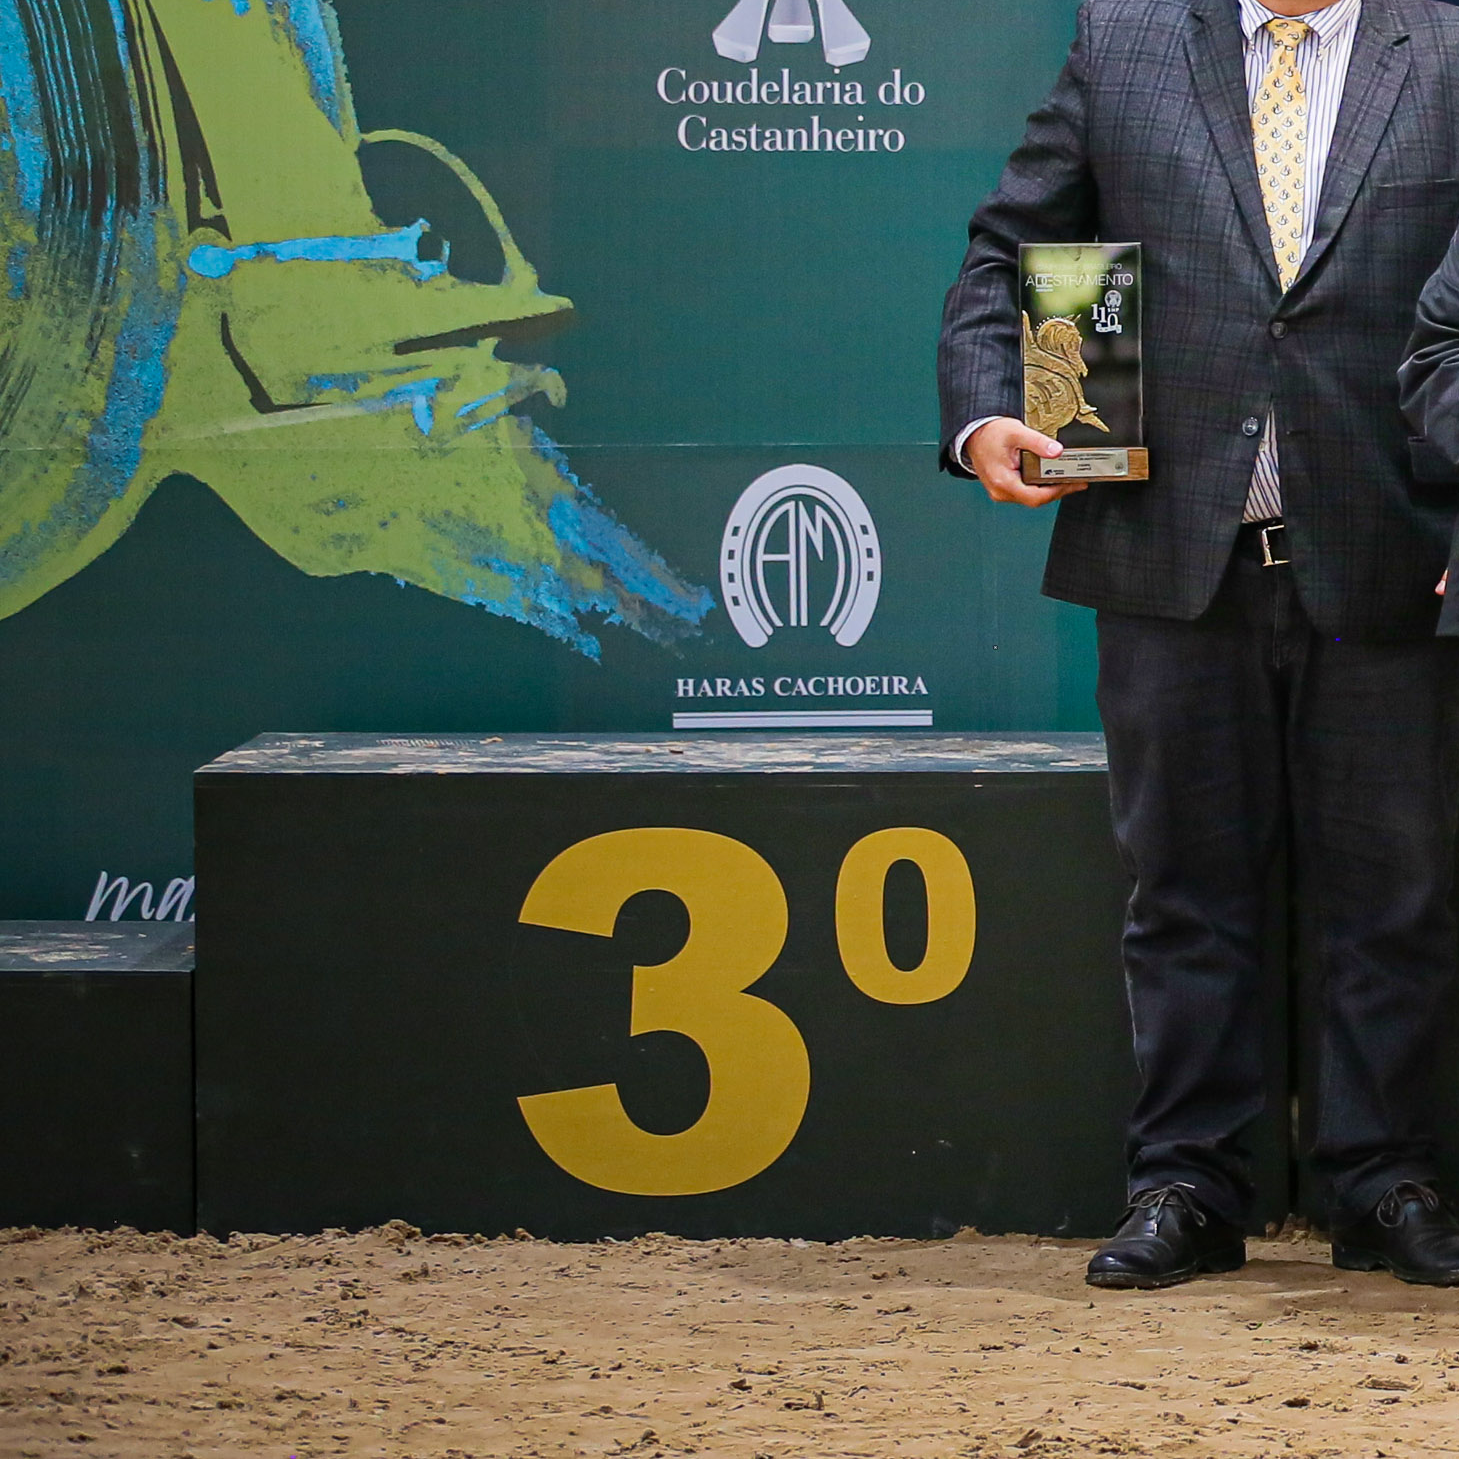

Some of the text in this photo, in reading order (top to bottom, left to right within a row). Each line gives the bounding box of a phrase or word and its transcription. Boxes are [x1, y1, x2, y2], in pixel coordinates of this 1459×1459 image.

[656, 67, 926, 105] Coudelaria do
[677, 114, 906, 152] Castanheiro
[676, 676, 929, 698] HARAS CACHOEIRA
